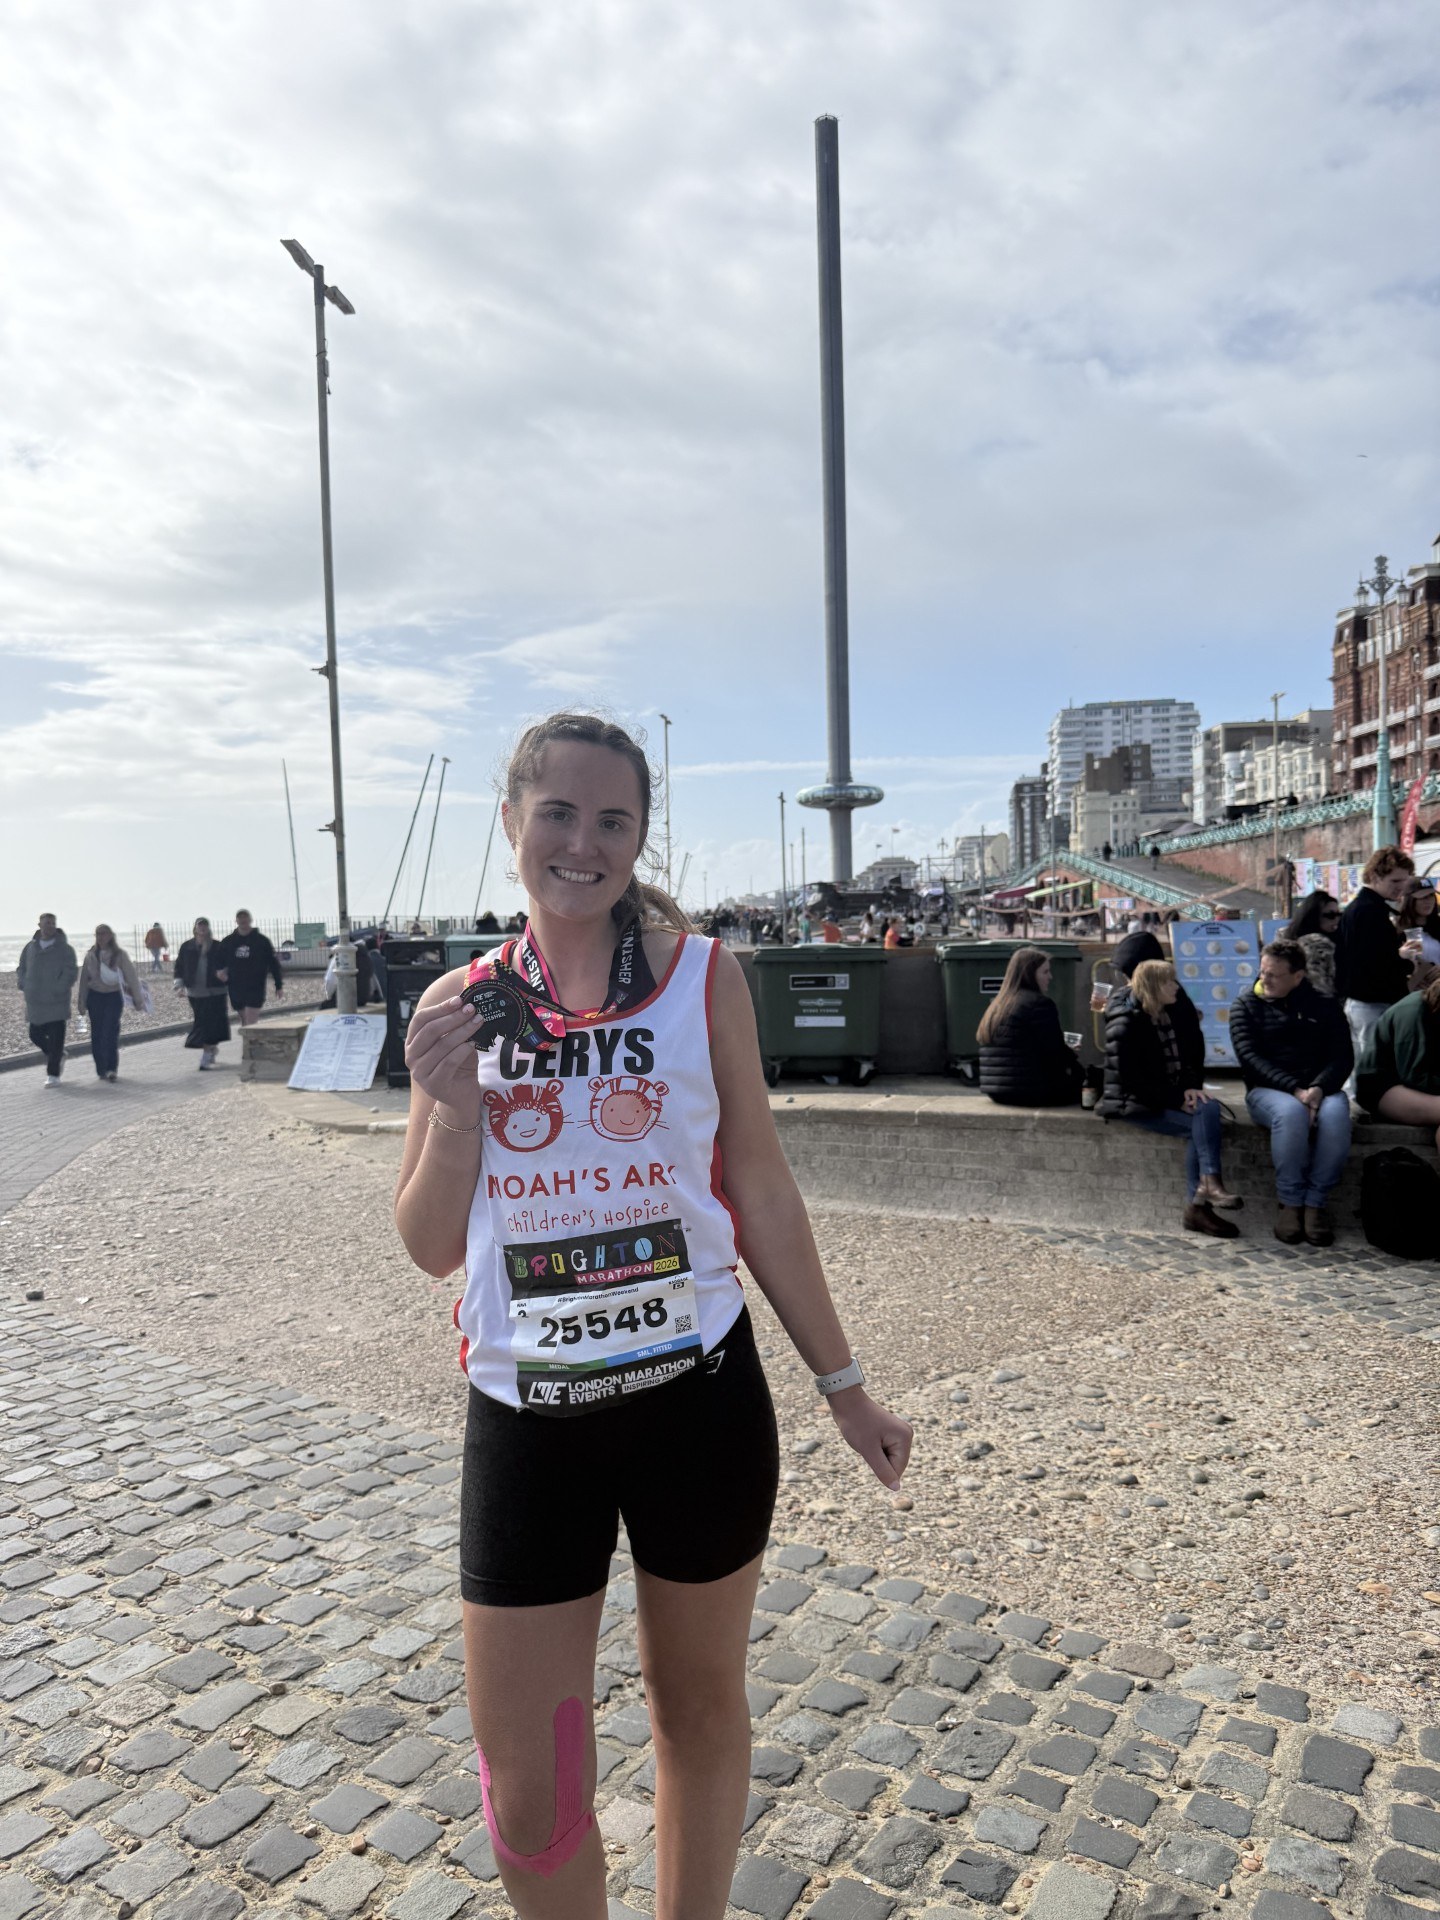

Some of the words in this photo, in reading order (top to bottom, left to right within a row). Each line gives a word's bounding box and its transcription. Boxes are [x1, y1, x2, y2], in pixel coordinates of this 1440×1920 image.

[500, 1028, 656, 1080] CERYS
[487, 1166, 611, 1200] NOAH'S
[604, 1198, 670, 1226] Hospice
[511, 1232, 678, 1279] BRIGHTON
[576, 1262, 653, 1285] MARATHON
[655, 1256, 679, 1272] 2026
[537, 1297, 668, 1348] 25548
[549, 1363, 570, 1371] MEDAL
[568, 1374, 623, 1393] LONDON
[624, 1356, 697, 1383] MARATHON
[568, 1387, 616, 1405] EVENTS
[623, 1378, 662, 1393] INSPIRING
